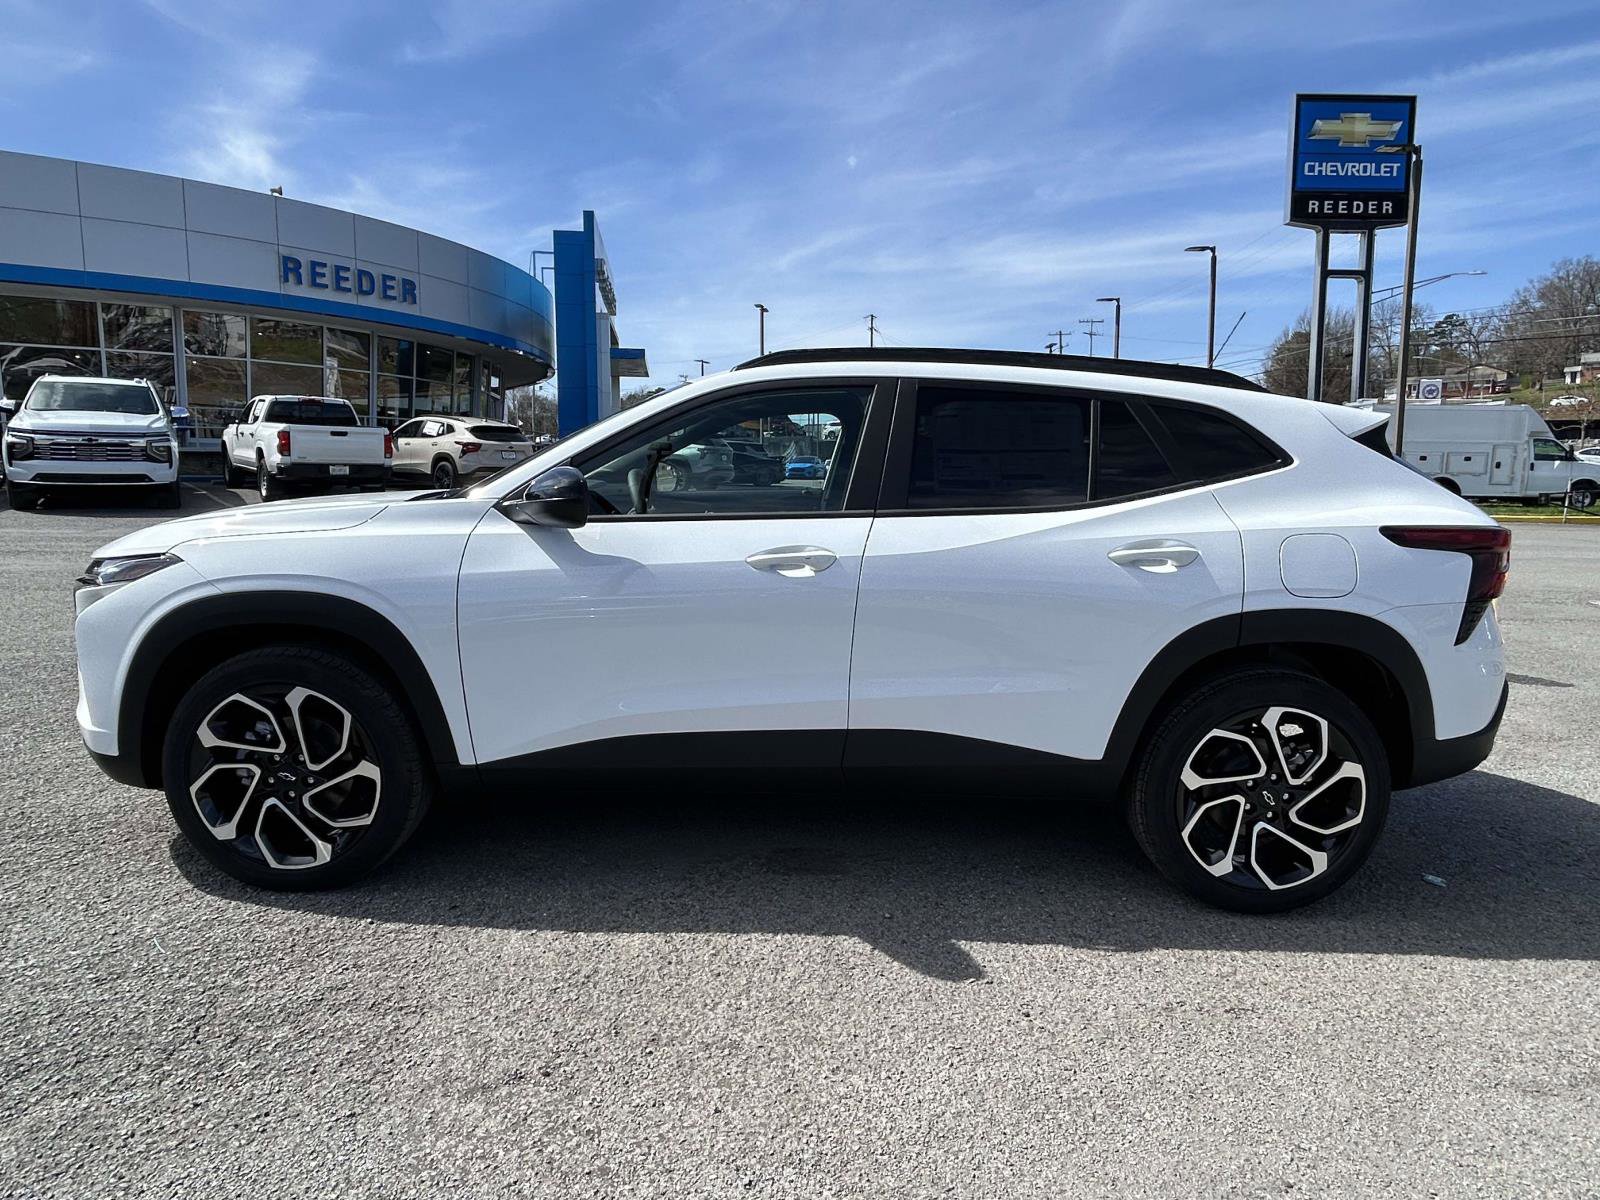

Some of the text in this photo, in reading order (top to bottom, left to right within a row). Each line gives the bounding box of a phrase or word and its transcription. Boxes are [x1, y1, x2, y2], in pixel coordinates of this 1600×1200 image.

[1303, 162, 1401, 177] CHEVROLET
[1308, 200, 1393, 214] REEDER
[281, 255, 417, 305] REEDER
